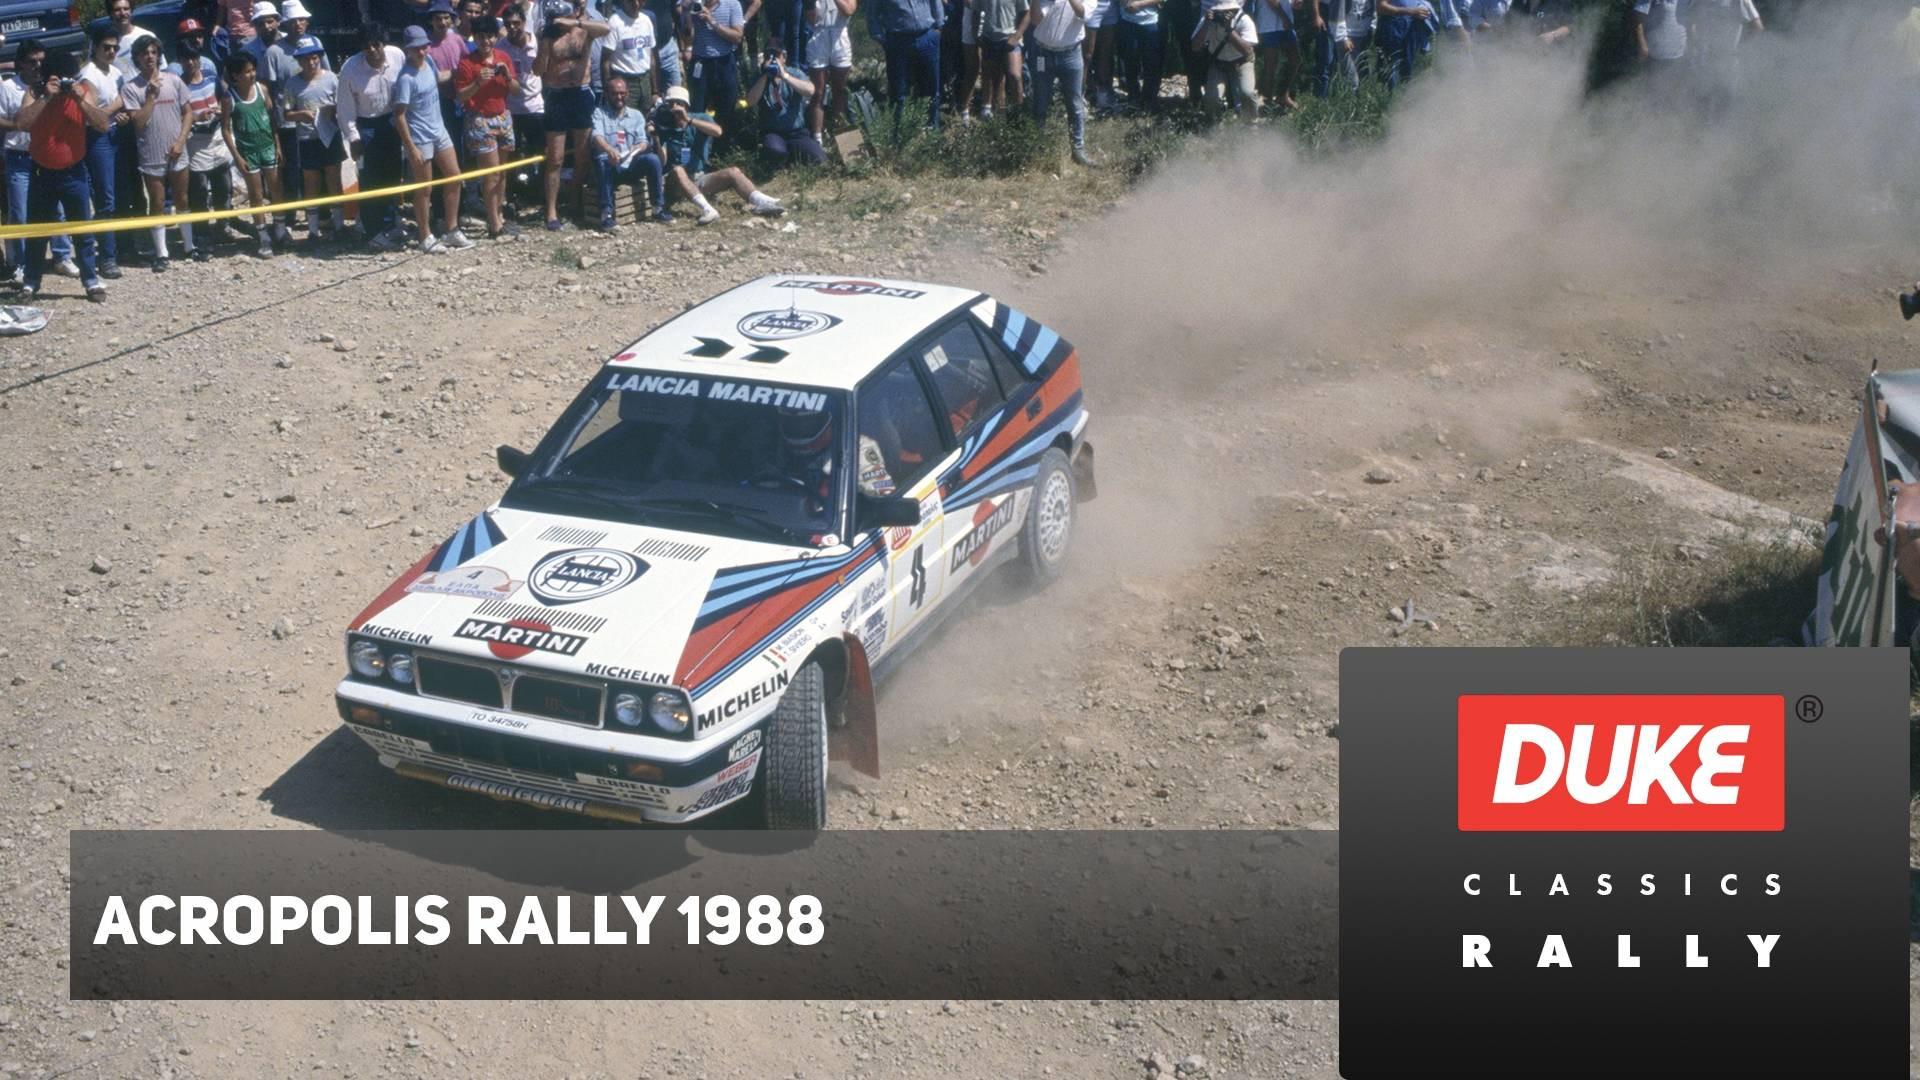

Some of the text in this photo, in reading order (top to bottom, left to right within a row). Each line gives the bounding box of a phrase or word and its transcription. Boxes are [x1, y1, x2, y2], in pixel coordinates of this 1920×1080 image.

[780, 280, 920, 299] MARTINI
[606, 373, 828, 411] LANCIA MARTINI
[953, 498, 1014, 567] MARTINI
[557, 565, 609, 582] LANCIA
[909, 543, 926, 609] 4
[361, 623, 433, 645] MICHELIN
[459, 621, 582, 653] MARTINI
[585, 662, 671, 684] MICHELIN
[697, 669, 790, 731] MICHELIN
[717, 752, 757, 782] WEBER
